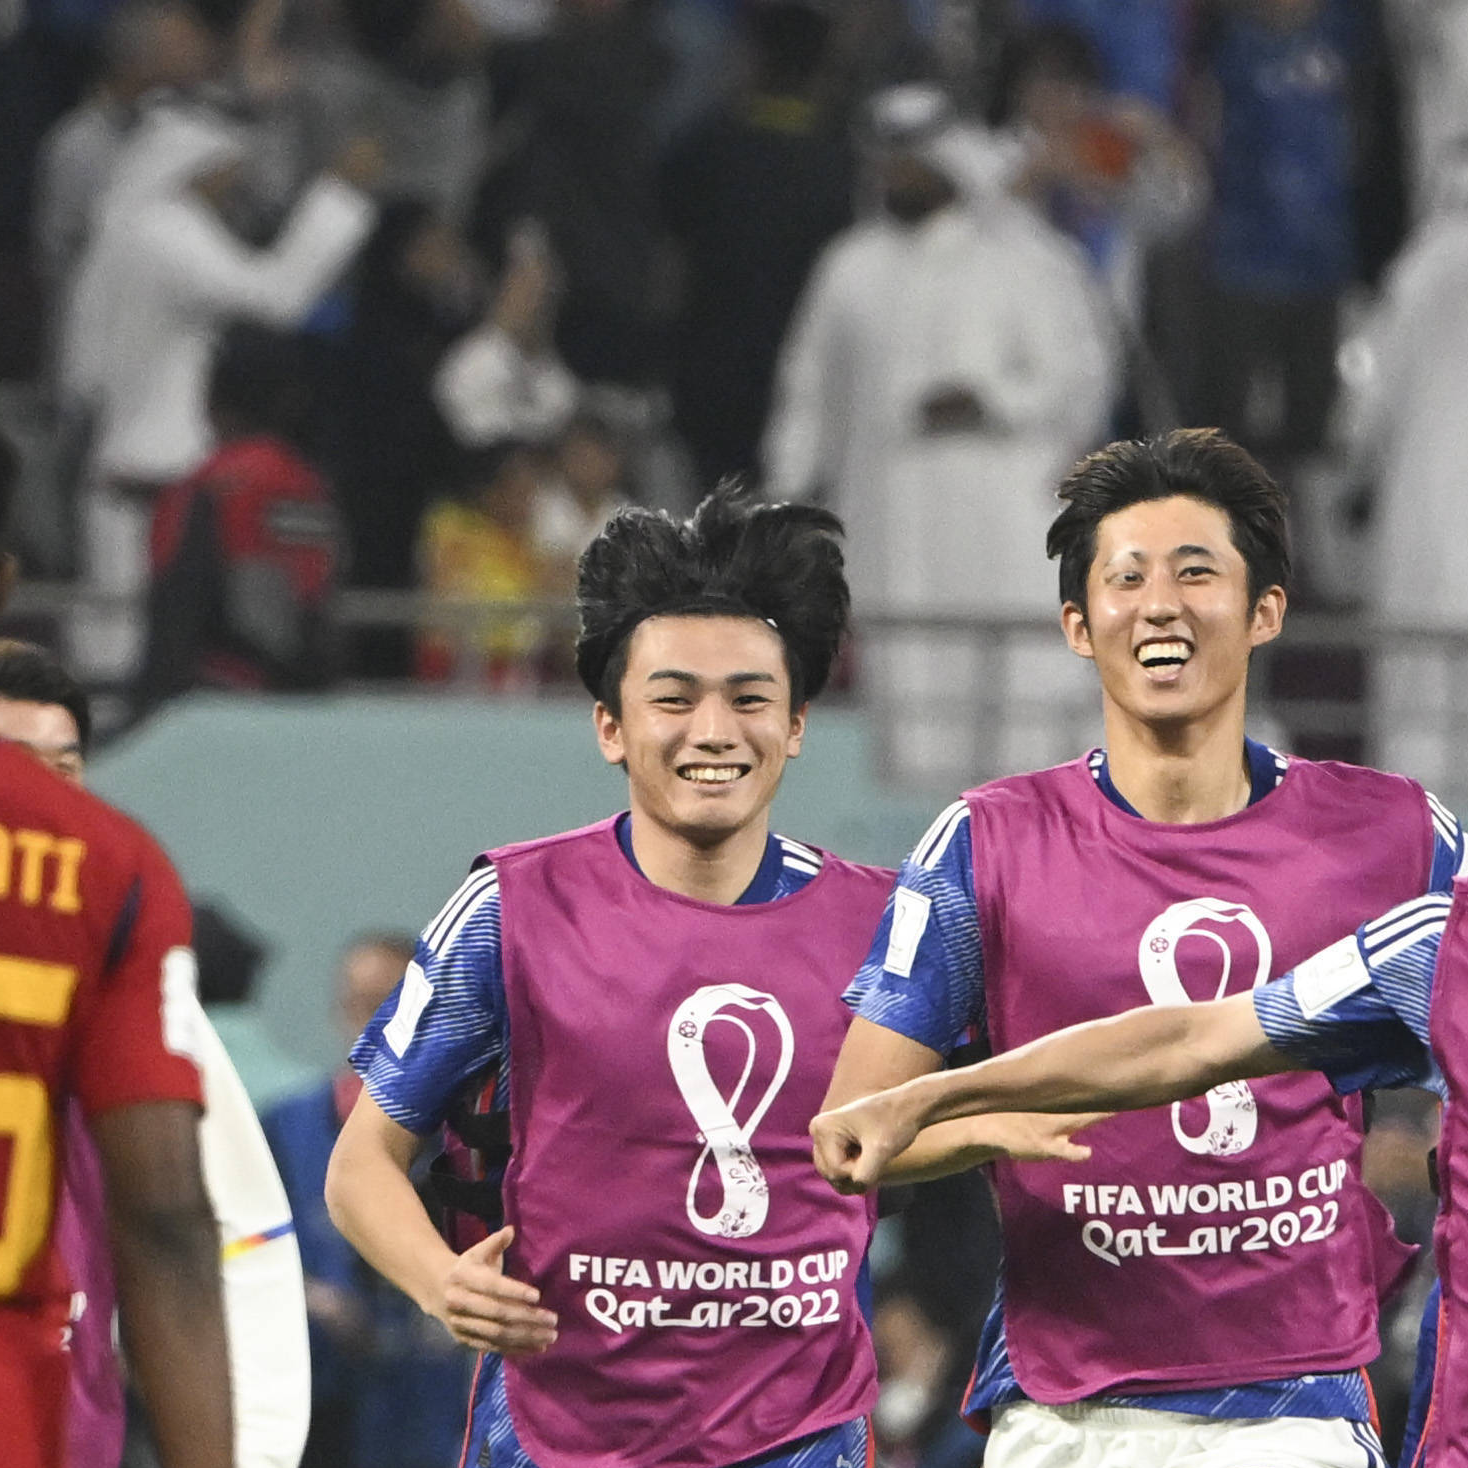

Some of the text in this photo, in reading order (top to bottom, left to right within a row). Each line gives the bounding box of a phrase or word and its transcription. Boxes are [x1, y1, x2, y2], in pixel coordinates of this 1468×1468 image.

[1062, 1158, 1348, 1216] FIFA WORLD CUP
[569, 1249, 849, 1291] FIFA WORLD CUP
